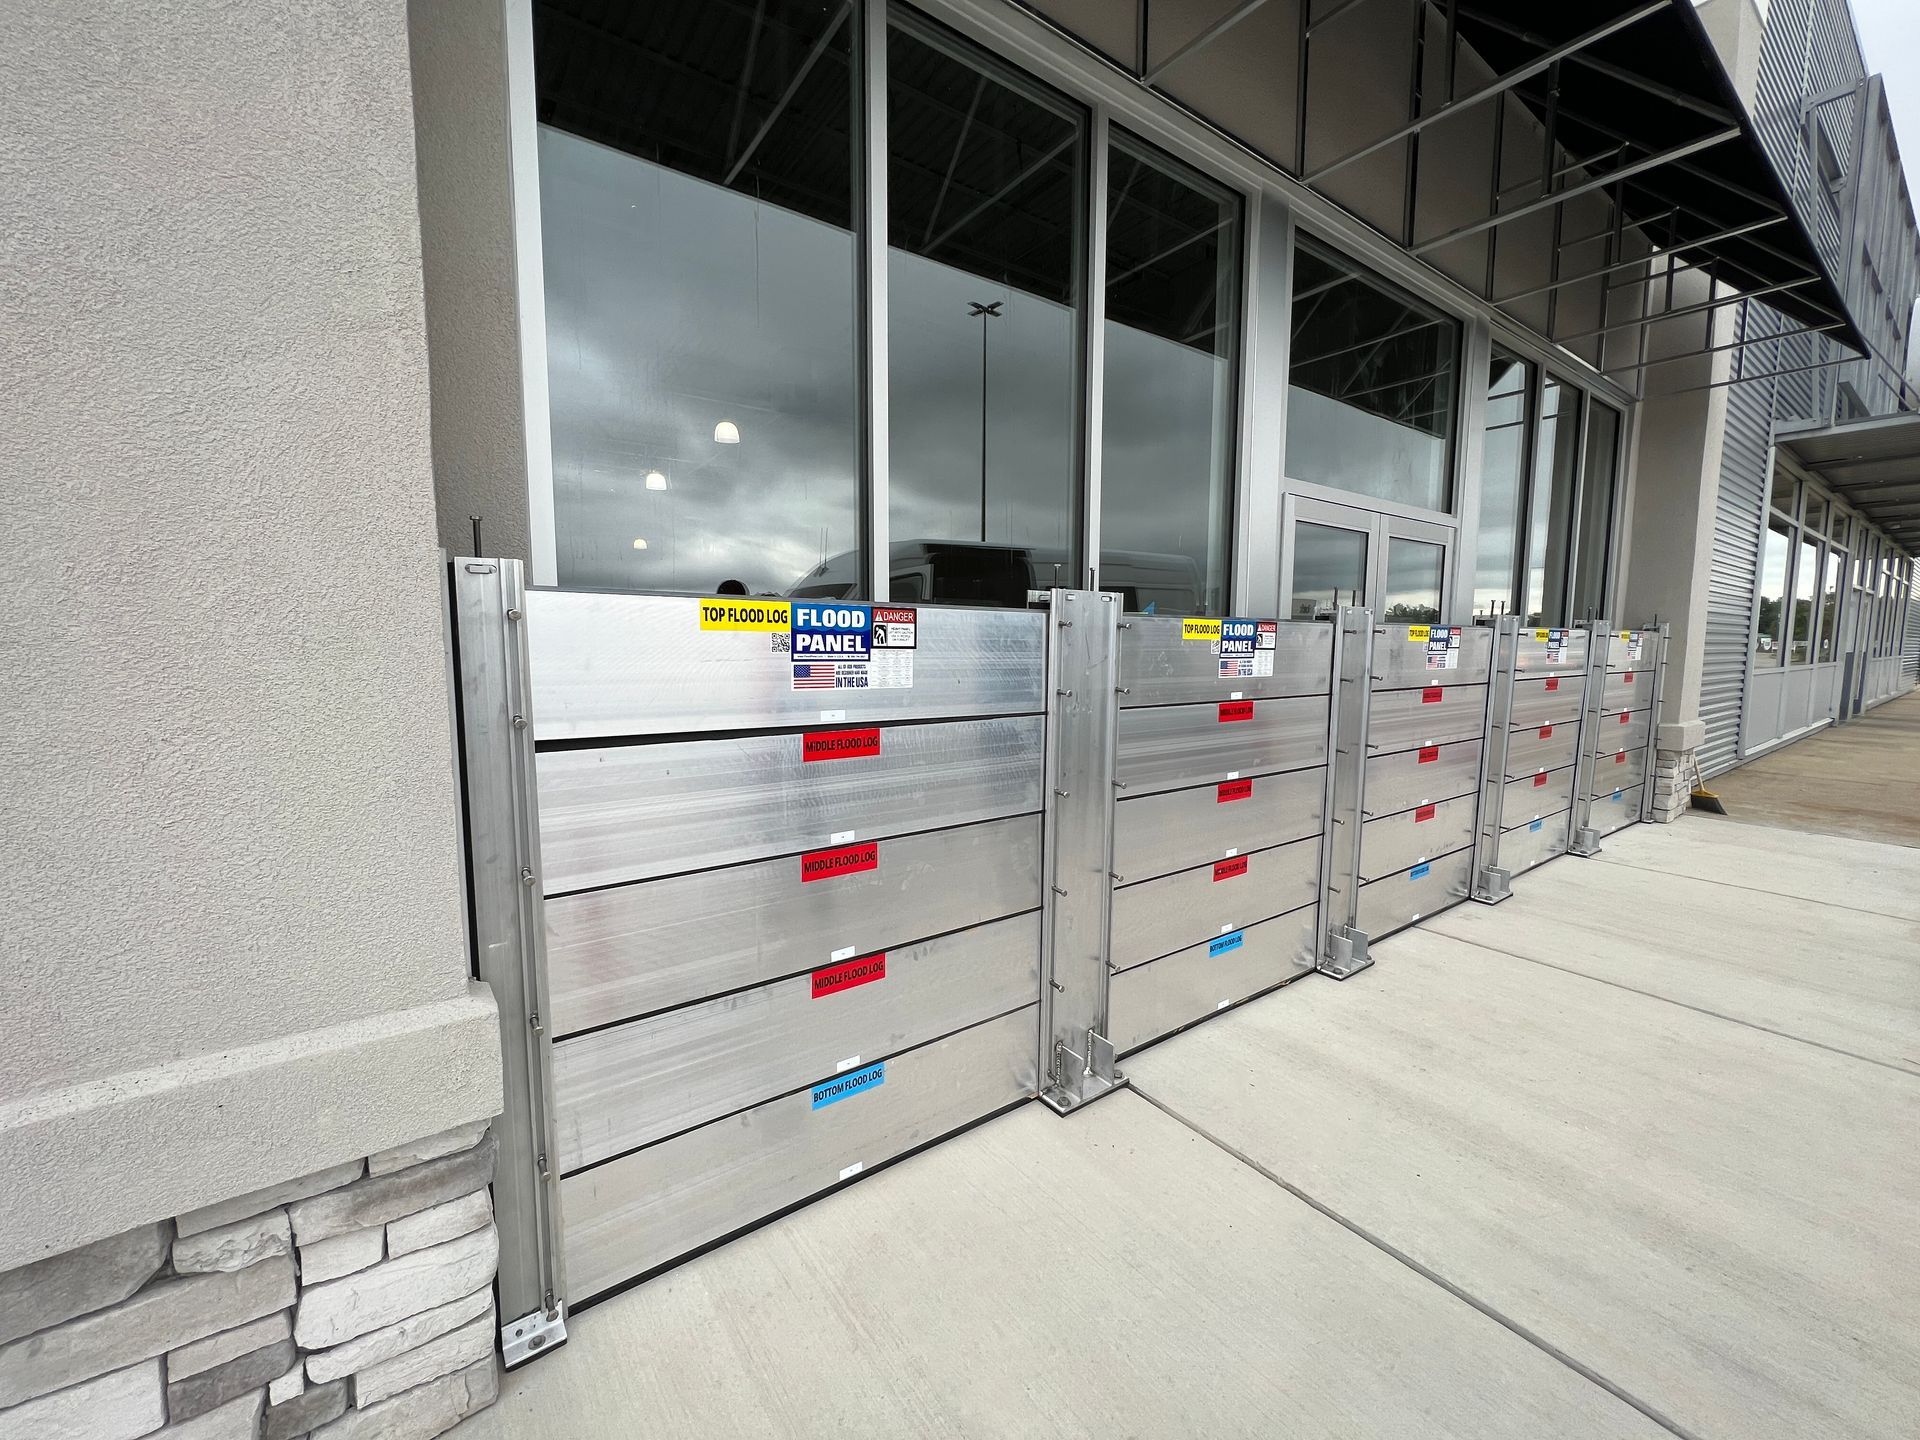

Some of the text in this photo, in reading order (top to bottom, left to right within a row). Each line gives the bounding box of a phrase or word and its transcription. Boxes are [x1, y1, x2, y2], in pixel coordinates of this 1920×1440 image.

[703, 607, 788, 624] TOP FLOOD LOG
[796, 608, 865, 628] FLOOD
[883, 611, 914, 622] DANGER
[1223, 624, 1254, 636] FLOOD
[1431, 629, 1449, 639] FLOOD
[796, 634, 866, 652] PANEL
[1221, 640, 1254, 653] PANEL
[1429, 641, 1447, 651] PANEL
[835, 676, 869, 688] IN THE USA
[805, 736, 878, 752] MIDDLE FLOOD LOG
[804, 850, 876, 873] MIDDLE FLOOD LOG
[814, 961, 884, 990] MIDDLE FLOOD LOG
[813, 1068, 883, 1103] BOTTOM FLOOD LOG
